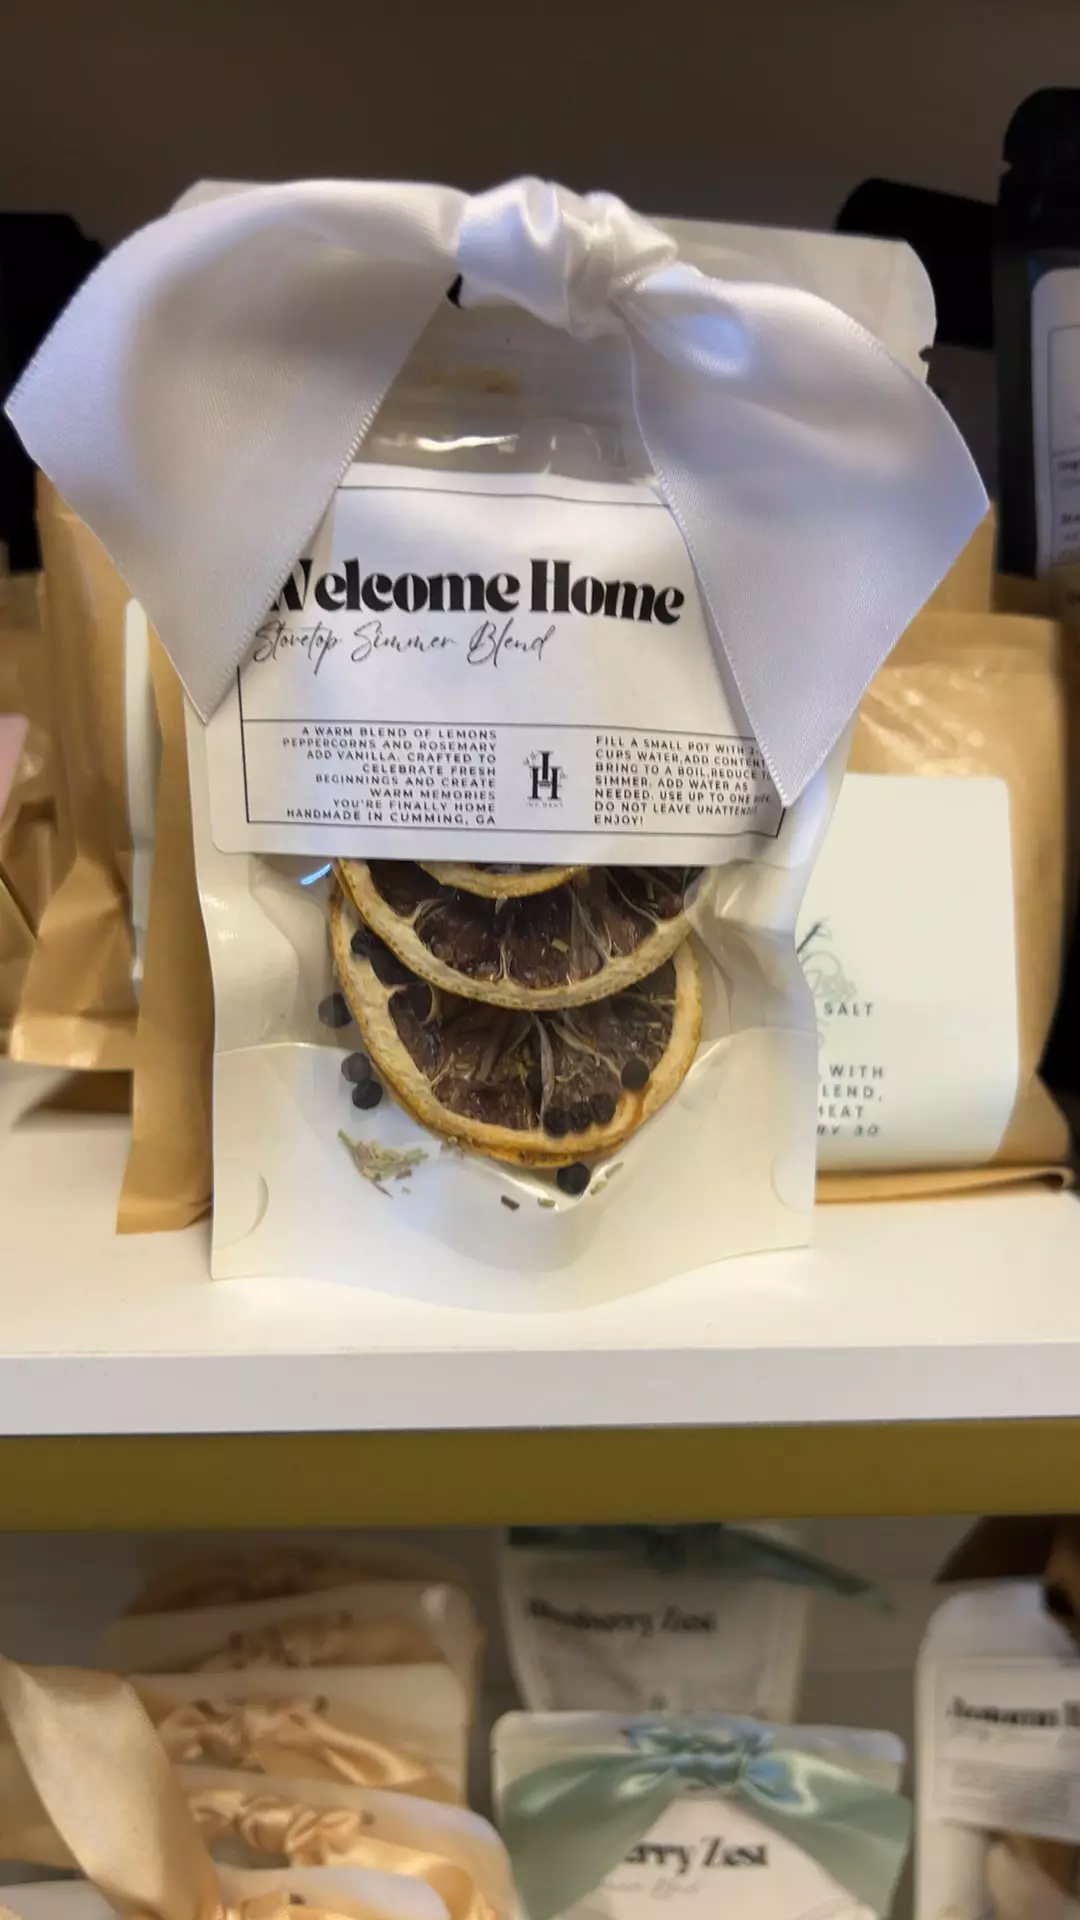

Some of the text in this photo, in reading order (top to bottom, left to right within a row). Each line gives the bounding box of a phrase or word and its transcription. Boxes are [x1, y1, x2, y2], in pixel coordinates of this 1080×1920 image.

[268, 556, 685, 626] Welcome Home
[252, 617, 556, 676] Stovetop Simmer Blend
[302, 726, 498, 740] A WARM BLEND OF LEMONS
[282, 738, 498, 751] PEPPERCORNS AND ROSEMARY
[595, 735, 625, 746] FILL
[631, 737, 638, 747] A
[643, 738, 683, 750] SMALL
[688, 742, 710, 751] POT
[715, 744, 744, 754] WITH
[306, 750, 332, 760] ADD
[407, 752, 472, 763] CRAFTED
[478, 754, 497, 764] TO
[595, 749, 632, 760] CUPS
[714, 755, 766, 768] CONTENT
[362, 764, 497, 776] CELEBRATE FRESH
[595, 763, 638, 773] BRING
[644, 764, 660, 774] TO
[665, 765, 672, 775] A
[315, 774, 497, 788] BEGINNINGS AND CREATE
[658, 777, 684, 788] ADD
[689, 779, 729, 790] WATER
[734, 781, 748, 791] AS
[369, 788, 497, 800] WARM MEMORIES
[660, 791, 683, 801] USE
[688, 792, 704, 801] UP
[709, 793, 725, 802] TO
[729, 794, 750, 804] ONE
[333, 799, 496, 812] YOU'RE FINALLY HOME
[594, 801, 615, 812] DO
[621, 802, 647, 812] NOT
[653, 804, 691, 814] LEAVE
[286, 808, 496, 826] HANDMADE IN CUMMING, GA
[594, 814, 644, 826] ENJOY!
[823, 1002, 875, 1018] SALT
[829, 1064, 884, 1079] WITH
[822, 1084, 882, 1102] LEND,
[699, 1835, 769, 1869] Zest
